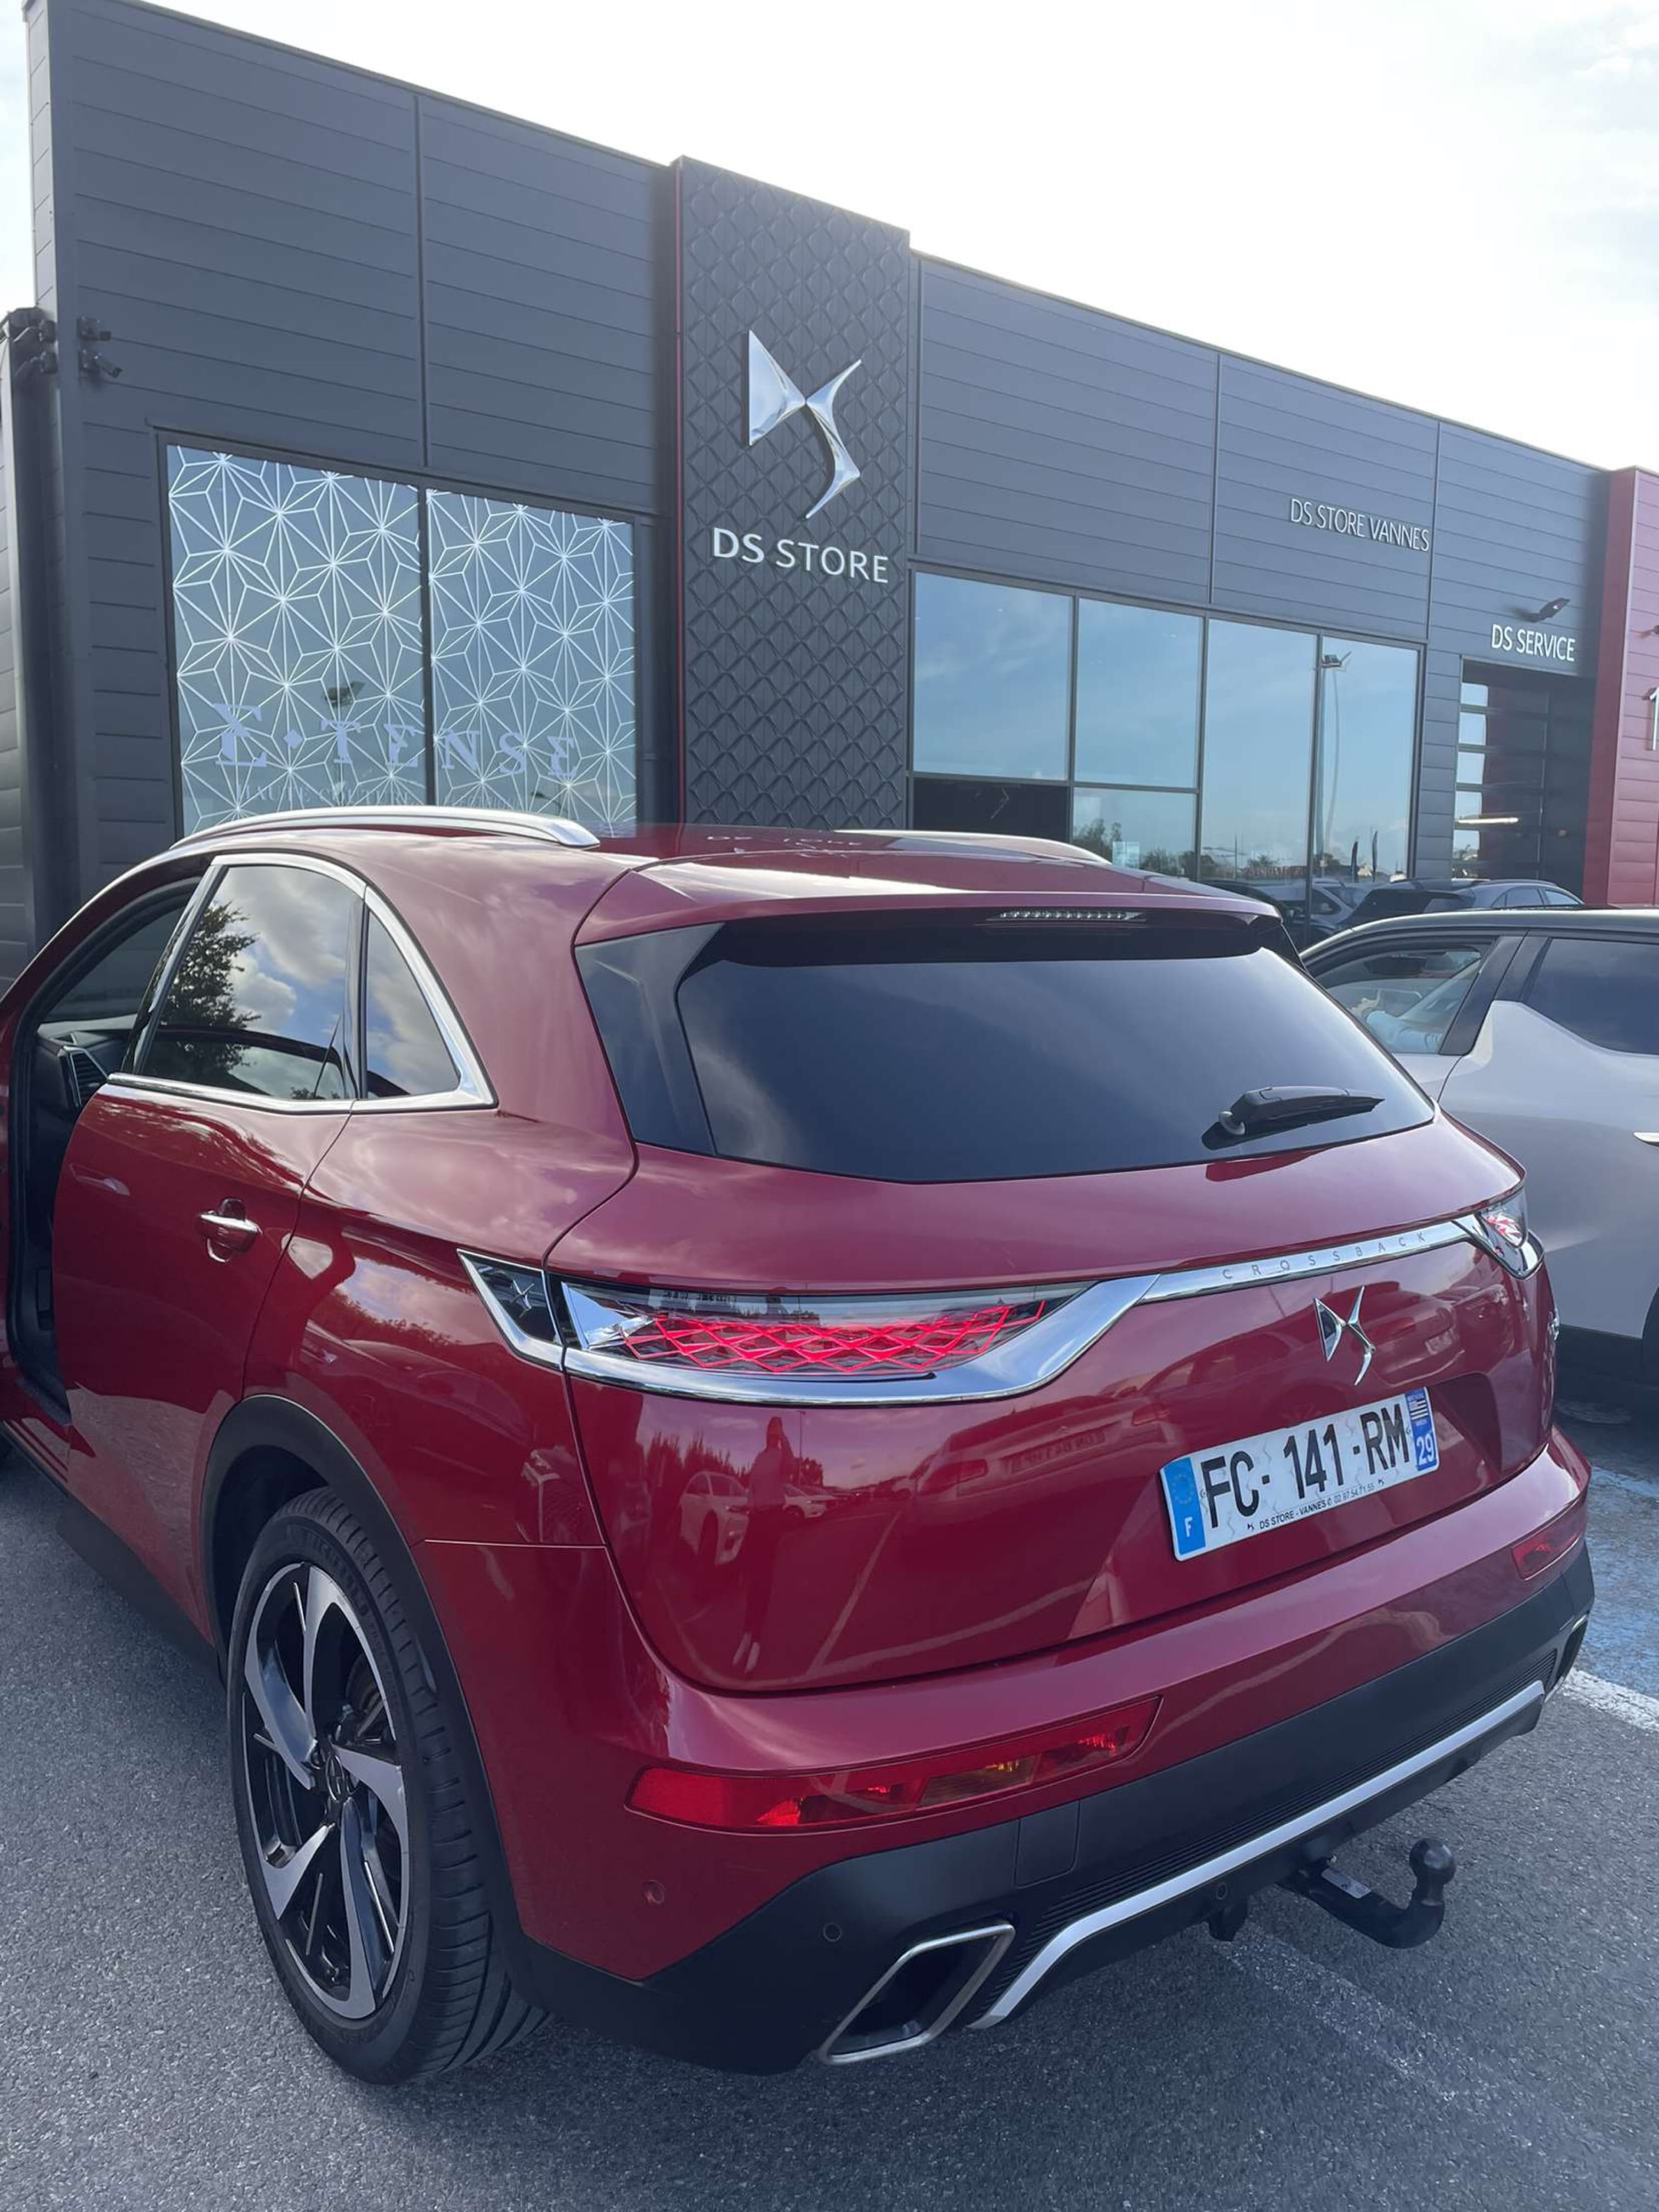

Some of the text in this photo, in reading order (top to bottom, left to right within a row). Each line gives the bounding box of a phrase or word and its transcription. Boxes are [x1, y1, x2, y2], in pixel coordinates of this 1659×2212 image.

[1290, 498, 1430, 552] DS STORE VANNES
[713, 527, 889, 584] DS STORE
[1491, 623, 1576, 662] DS SERVICE
[1222, 1232, 1426, 1280] CROSSBACK
[1416, 1433, 1435, 1465] 29
[1184, 1516, 1194, 1538] F
[1260, 1519, 1269, 1530] DS
[1271, 1511, 1294, 1525] STORE
[1299, 1500, 1326, 1515] VANNES
